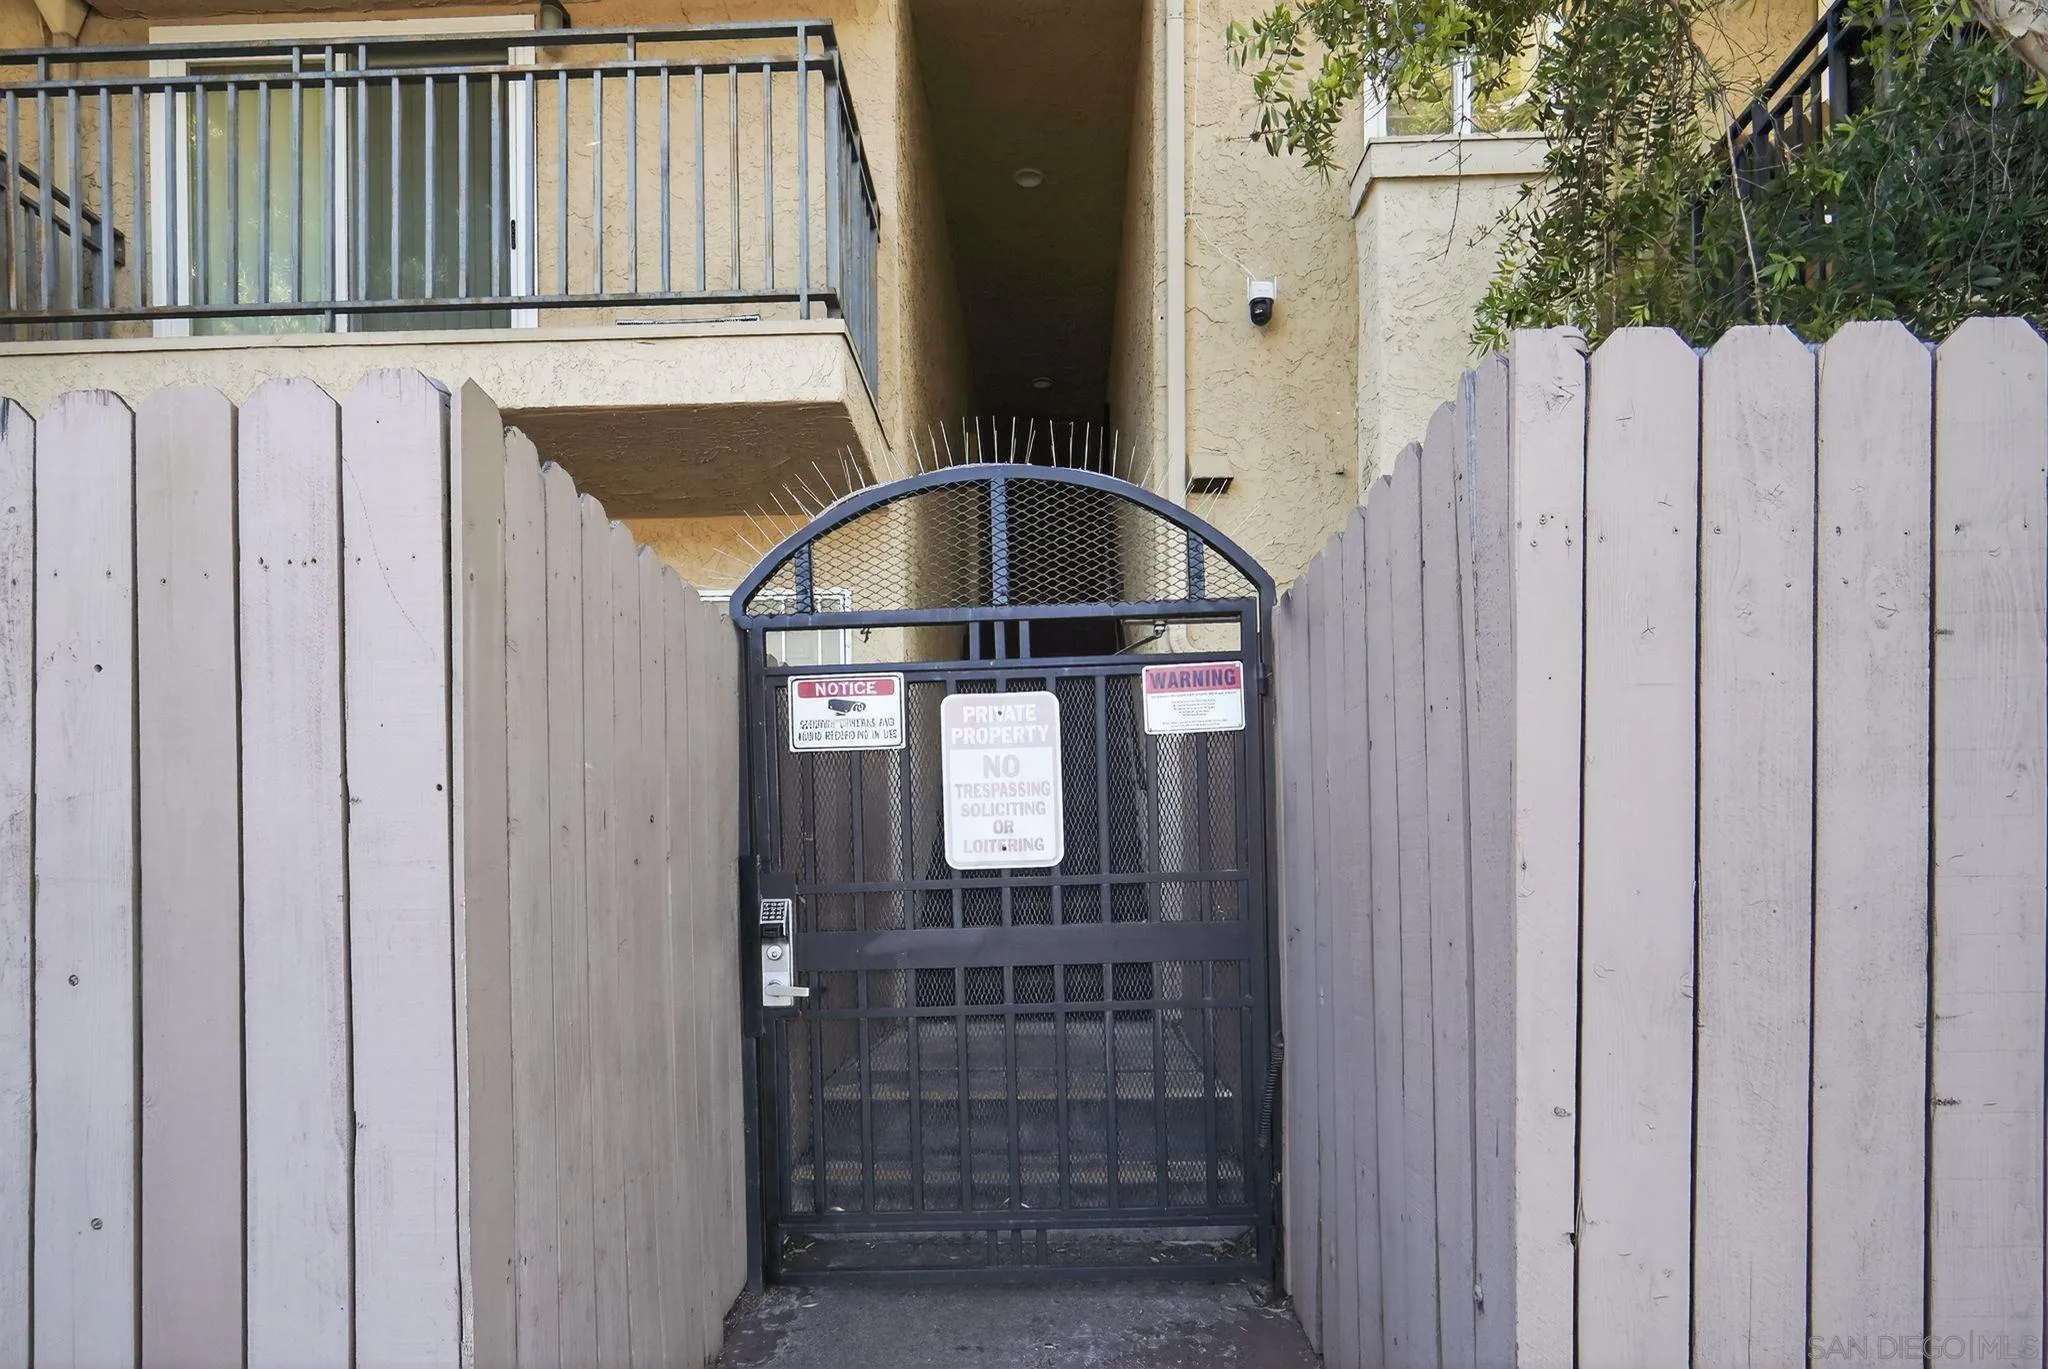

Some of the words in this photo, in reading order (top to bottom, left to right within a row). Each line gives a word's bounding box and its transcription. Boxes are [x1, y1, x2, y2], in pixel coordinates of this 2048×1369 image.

[1150, 668, 1236, 689] WARNING
[815, 681, 878, 697] NOTICE
[962, 704, 1037, 723] PRIVATE
[952, 724, 1049, 745] PROPERTY
[982, 754, 1020, 779] NO
[955, 781, 1051, 799] TRESPASSING
[961, 801, 1046, 818] SOLICITING
[993, 820, 1014, 834] OR
[964, 837, 1045, 853] LOITERING
